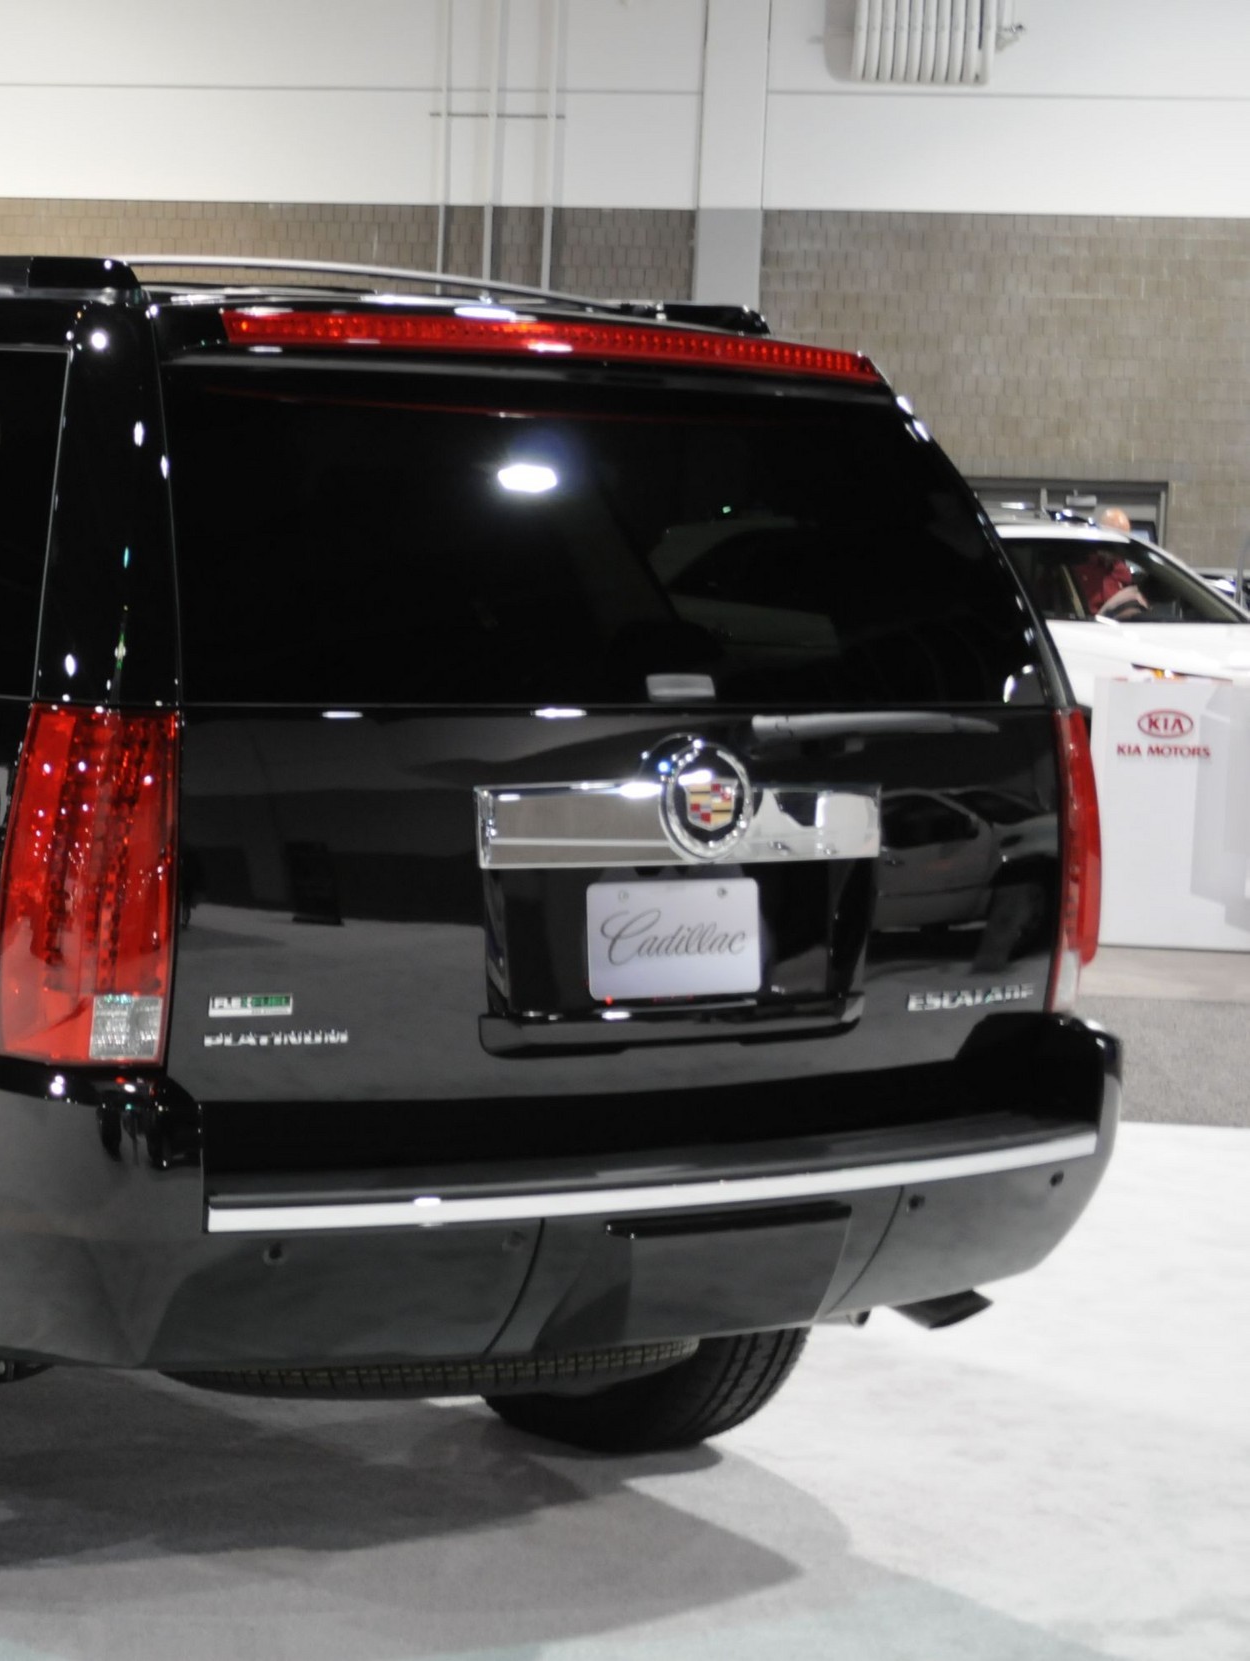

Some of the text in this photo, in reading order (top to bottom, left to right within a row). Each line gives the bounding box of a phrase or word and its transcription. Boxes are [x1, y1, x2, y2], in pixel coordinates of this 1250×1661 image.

[1146, 714, 1185, 734] KIA
[1116, 743, 1212, 759] KIA MOTORS
[600, 907, 747, 967] Cadillac
